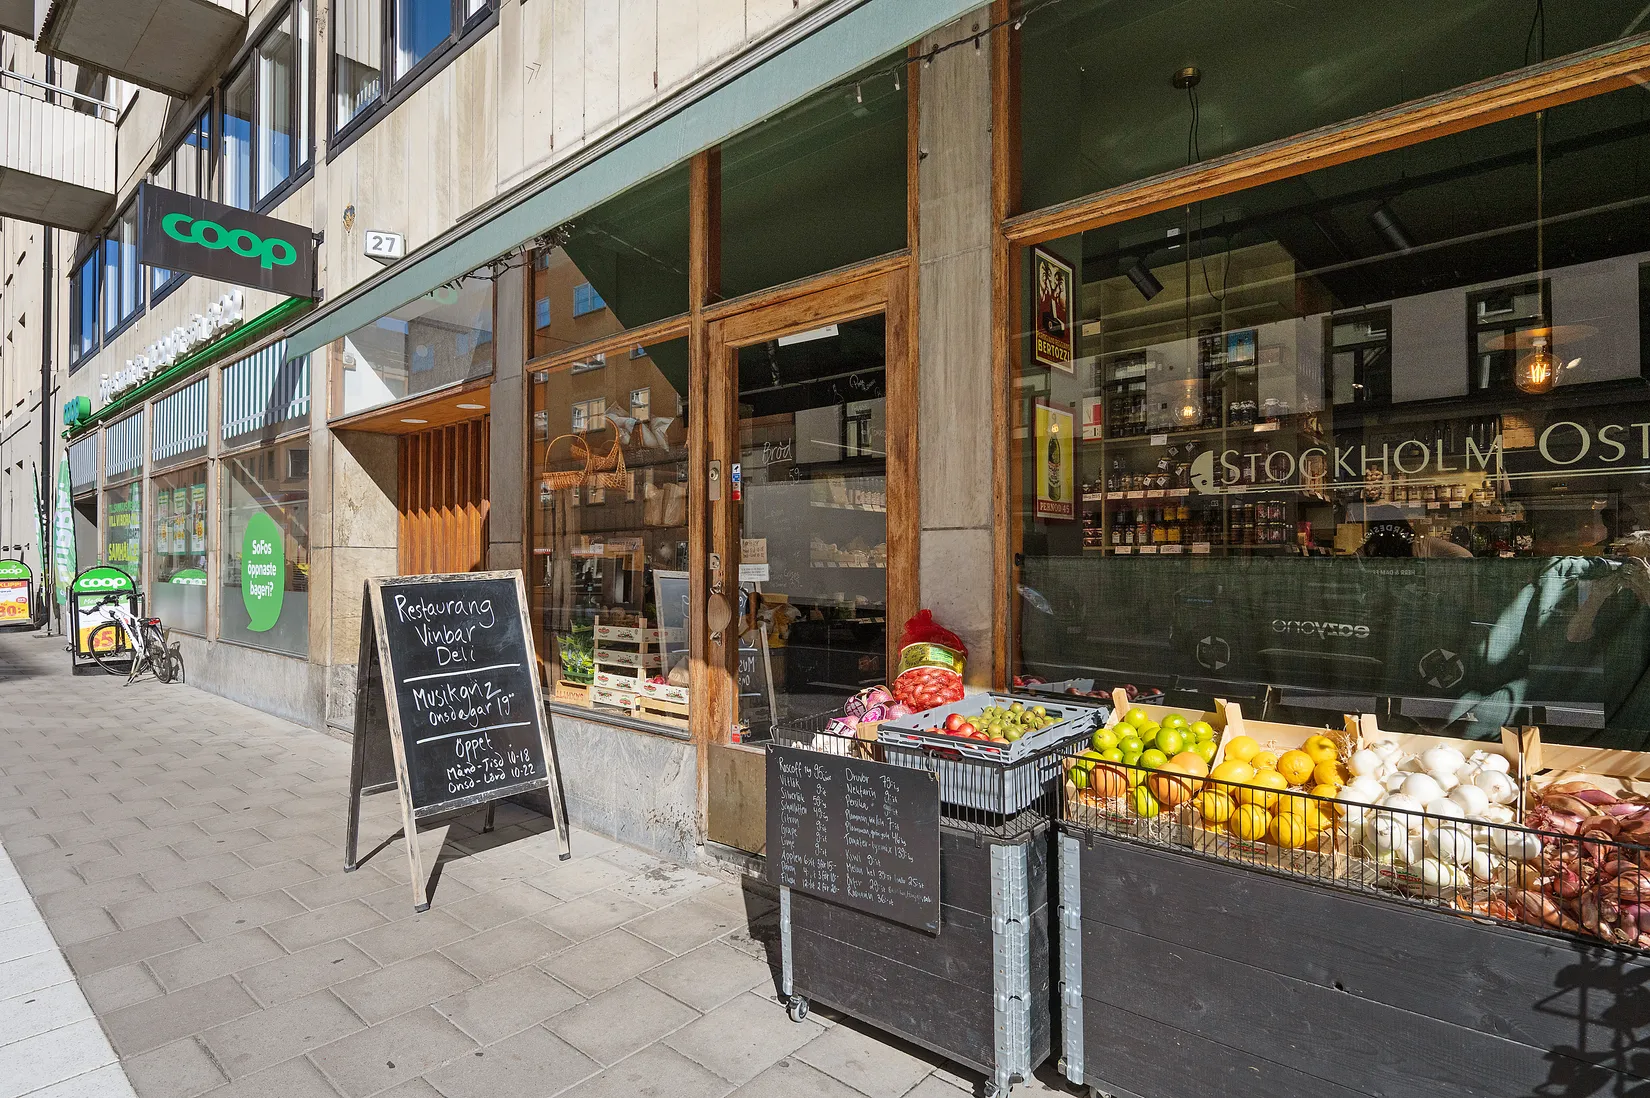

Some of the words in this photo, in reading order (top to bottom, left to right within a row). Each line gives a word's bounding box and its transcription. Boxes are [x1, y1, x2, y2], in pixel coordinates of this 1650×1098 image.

[162, 213, 297, 270] coop
[372, 235, 396, 253] 27
[1038, 339, 1070, 362] BERTOZZI
[1220, 435, 1503, 485] STOCKHOLM
[1539, 421, 1650, 465] OST
[252, 539, 272, 555] SoFos
[247, 560, 277, 578] öppnaste
[80, 577, 127, 589] coop
[249, 580, 274, 600] bageri?
[394, 594, 496, 628] Restaurang
[415, 623, 476, 647] Vinbar
[436, 645, 476, 666] Deli
[455, 731, 493, 762] Öppet
[845, 849, 862, 863] Kiwi
